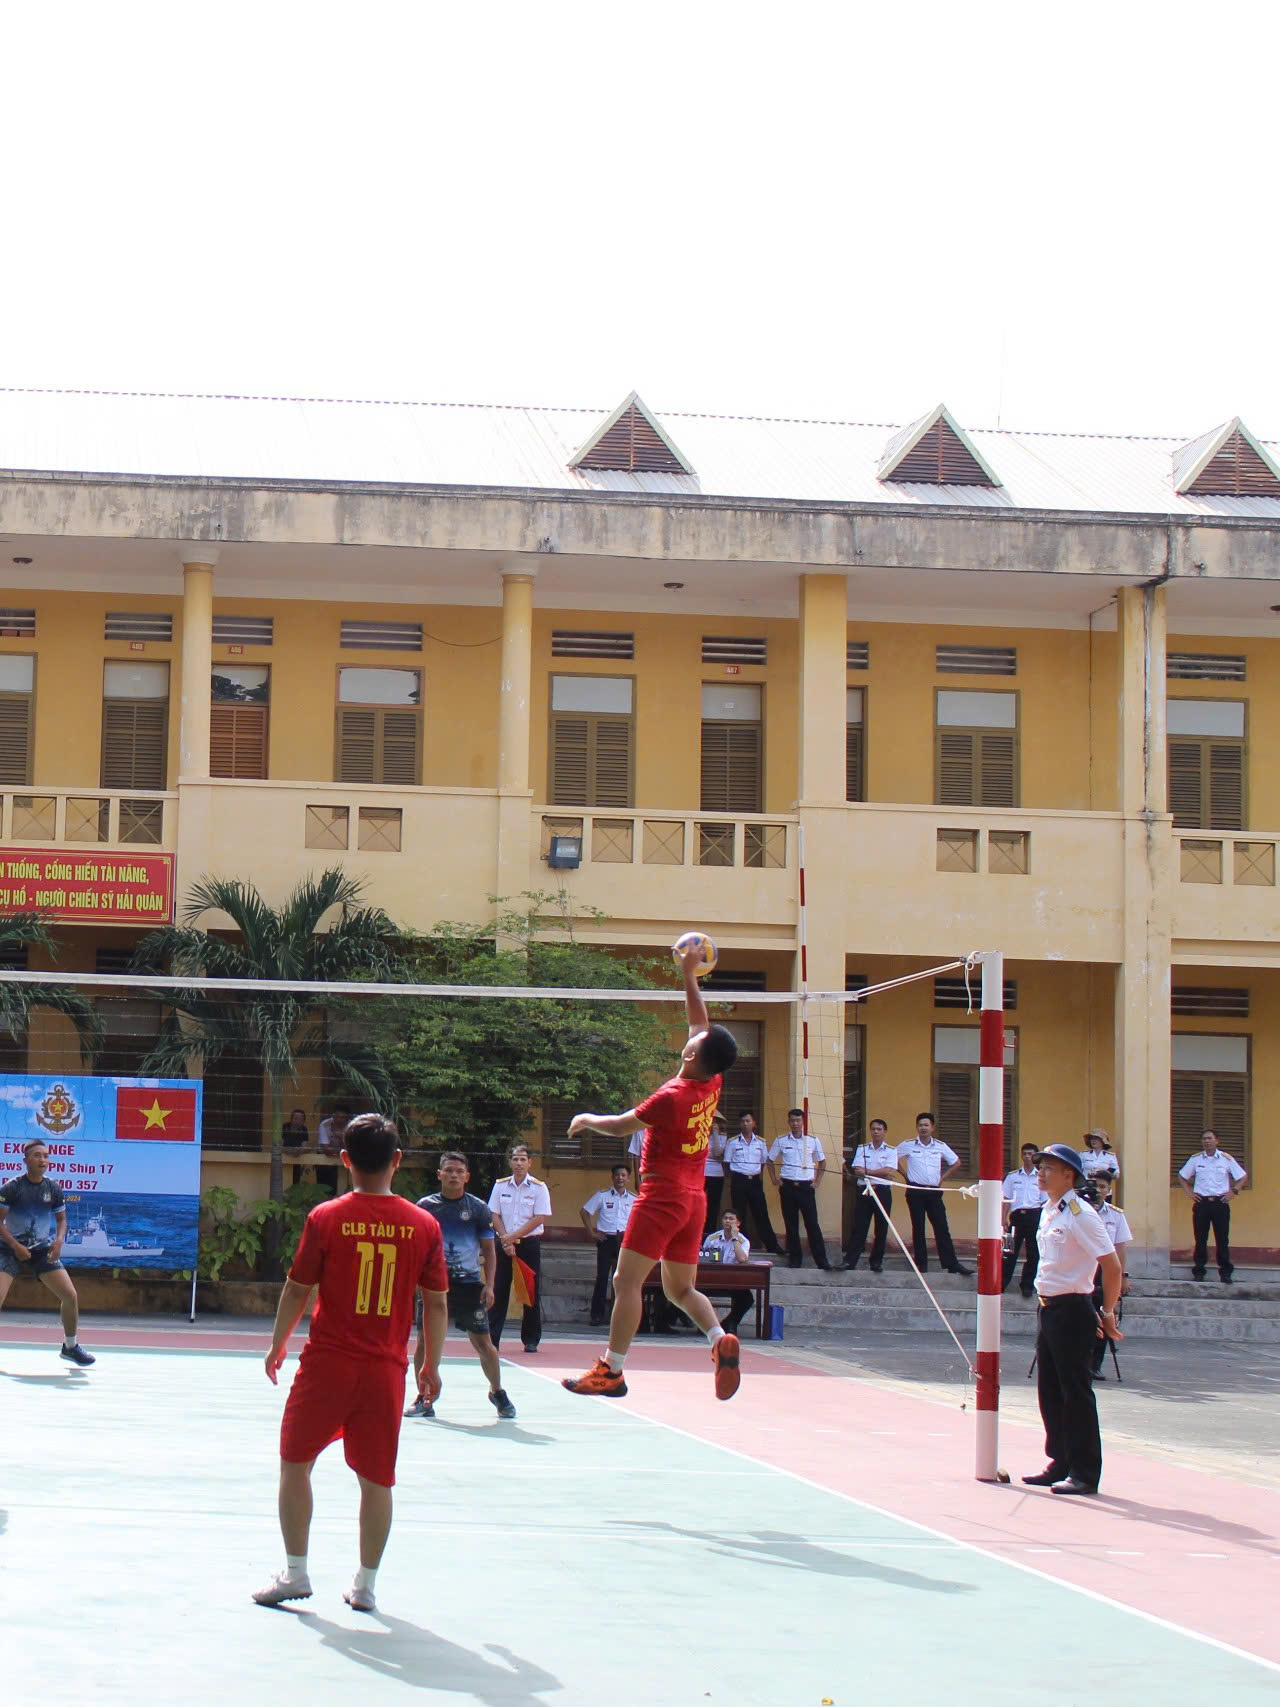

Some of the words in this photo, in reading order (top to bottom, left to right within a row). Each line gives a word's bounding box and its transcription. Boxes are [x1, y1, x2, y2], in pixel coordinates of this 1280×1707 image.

[45, 858, 72, 880] CỐNG
[75, 860, 98, 881] HIẾN
[101, 863, 116, 882] TÀI
[36, 887, 66, 908] NGƯỜI
[69, 887, 98, 908] CHIẾN
[117, 889, 133, 910] HẢI
[136, 891, 163, 912] QUÂN
[48, 1162, 65, 1172] PN
[69, 1163, 95, 1174] Ship
[100, 1164, 113, 1174] 17
[76, 1180, 98, 1190] 357
[341, 1222, 367, 1236] CLB
[369, 1221, 396, 1239] TÀU
[400, 1225, 416, 1240] 17
[355, 1241, 397, 1316] 11
